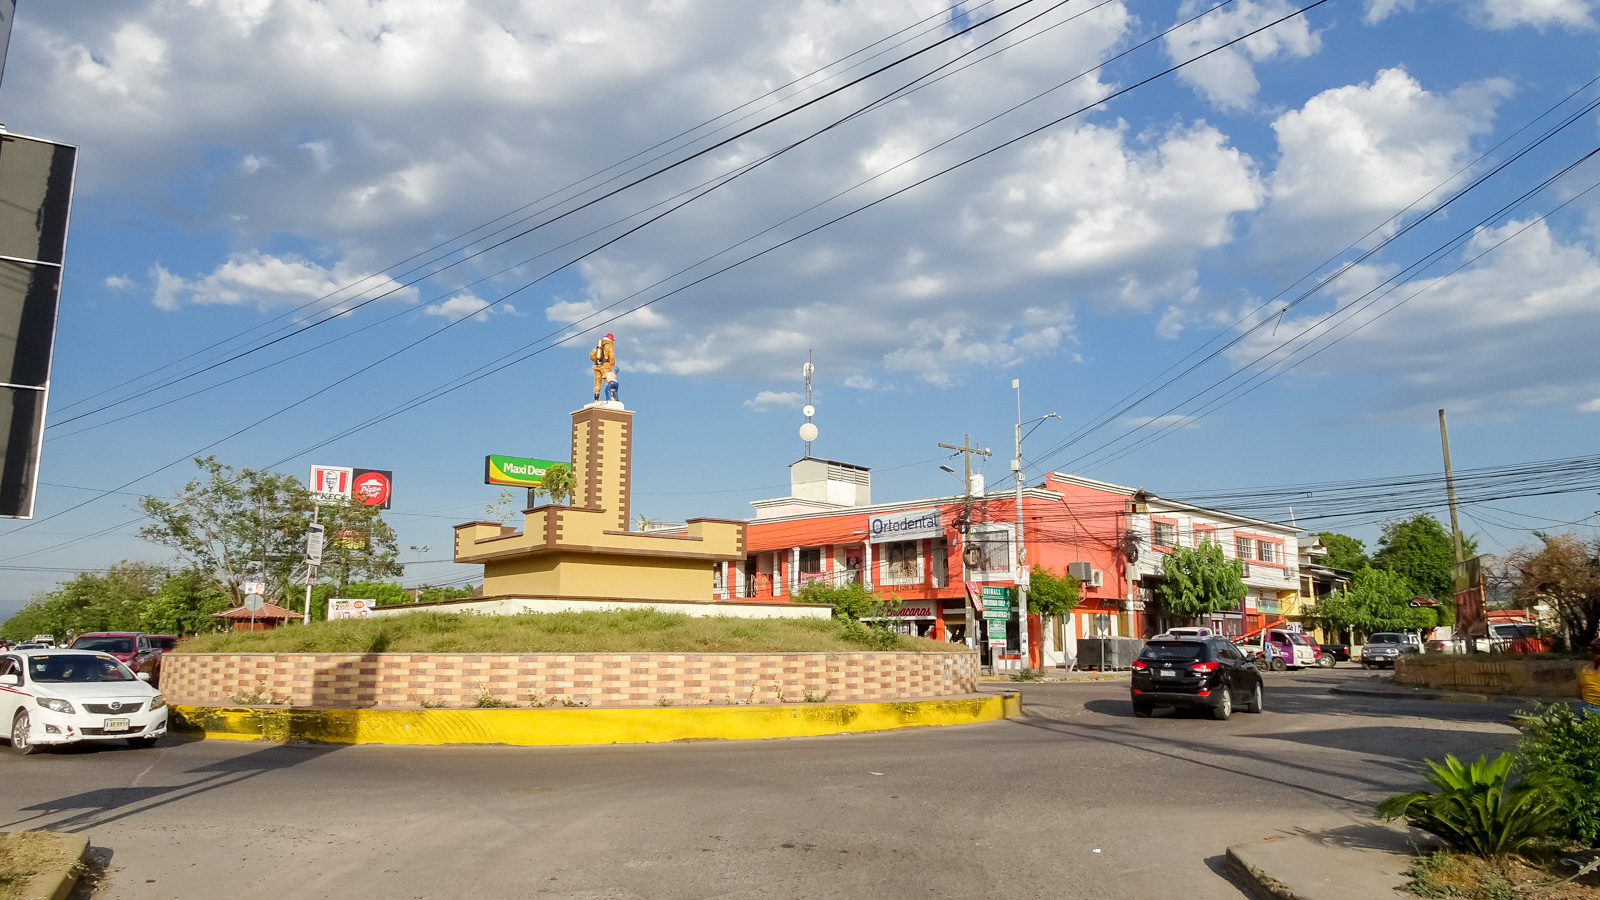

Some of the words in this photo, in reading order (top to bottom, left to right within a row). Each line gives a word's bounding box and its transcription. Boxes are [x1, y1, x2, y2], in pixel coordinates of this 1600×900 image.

[503, 462, 527, 474] Maxi
[360, 484, 382, 494] Pizza
[320, 492, 341, 501] KFC
[872, 513, 938, 534] Ortodental
